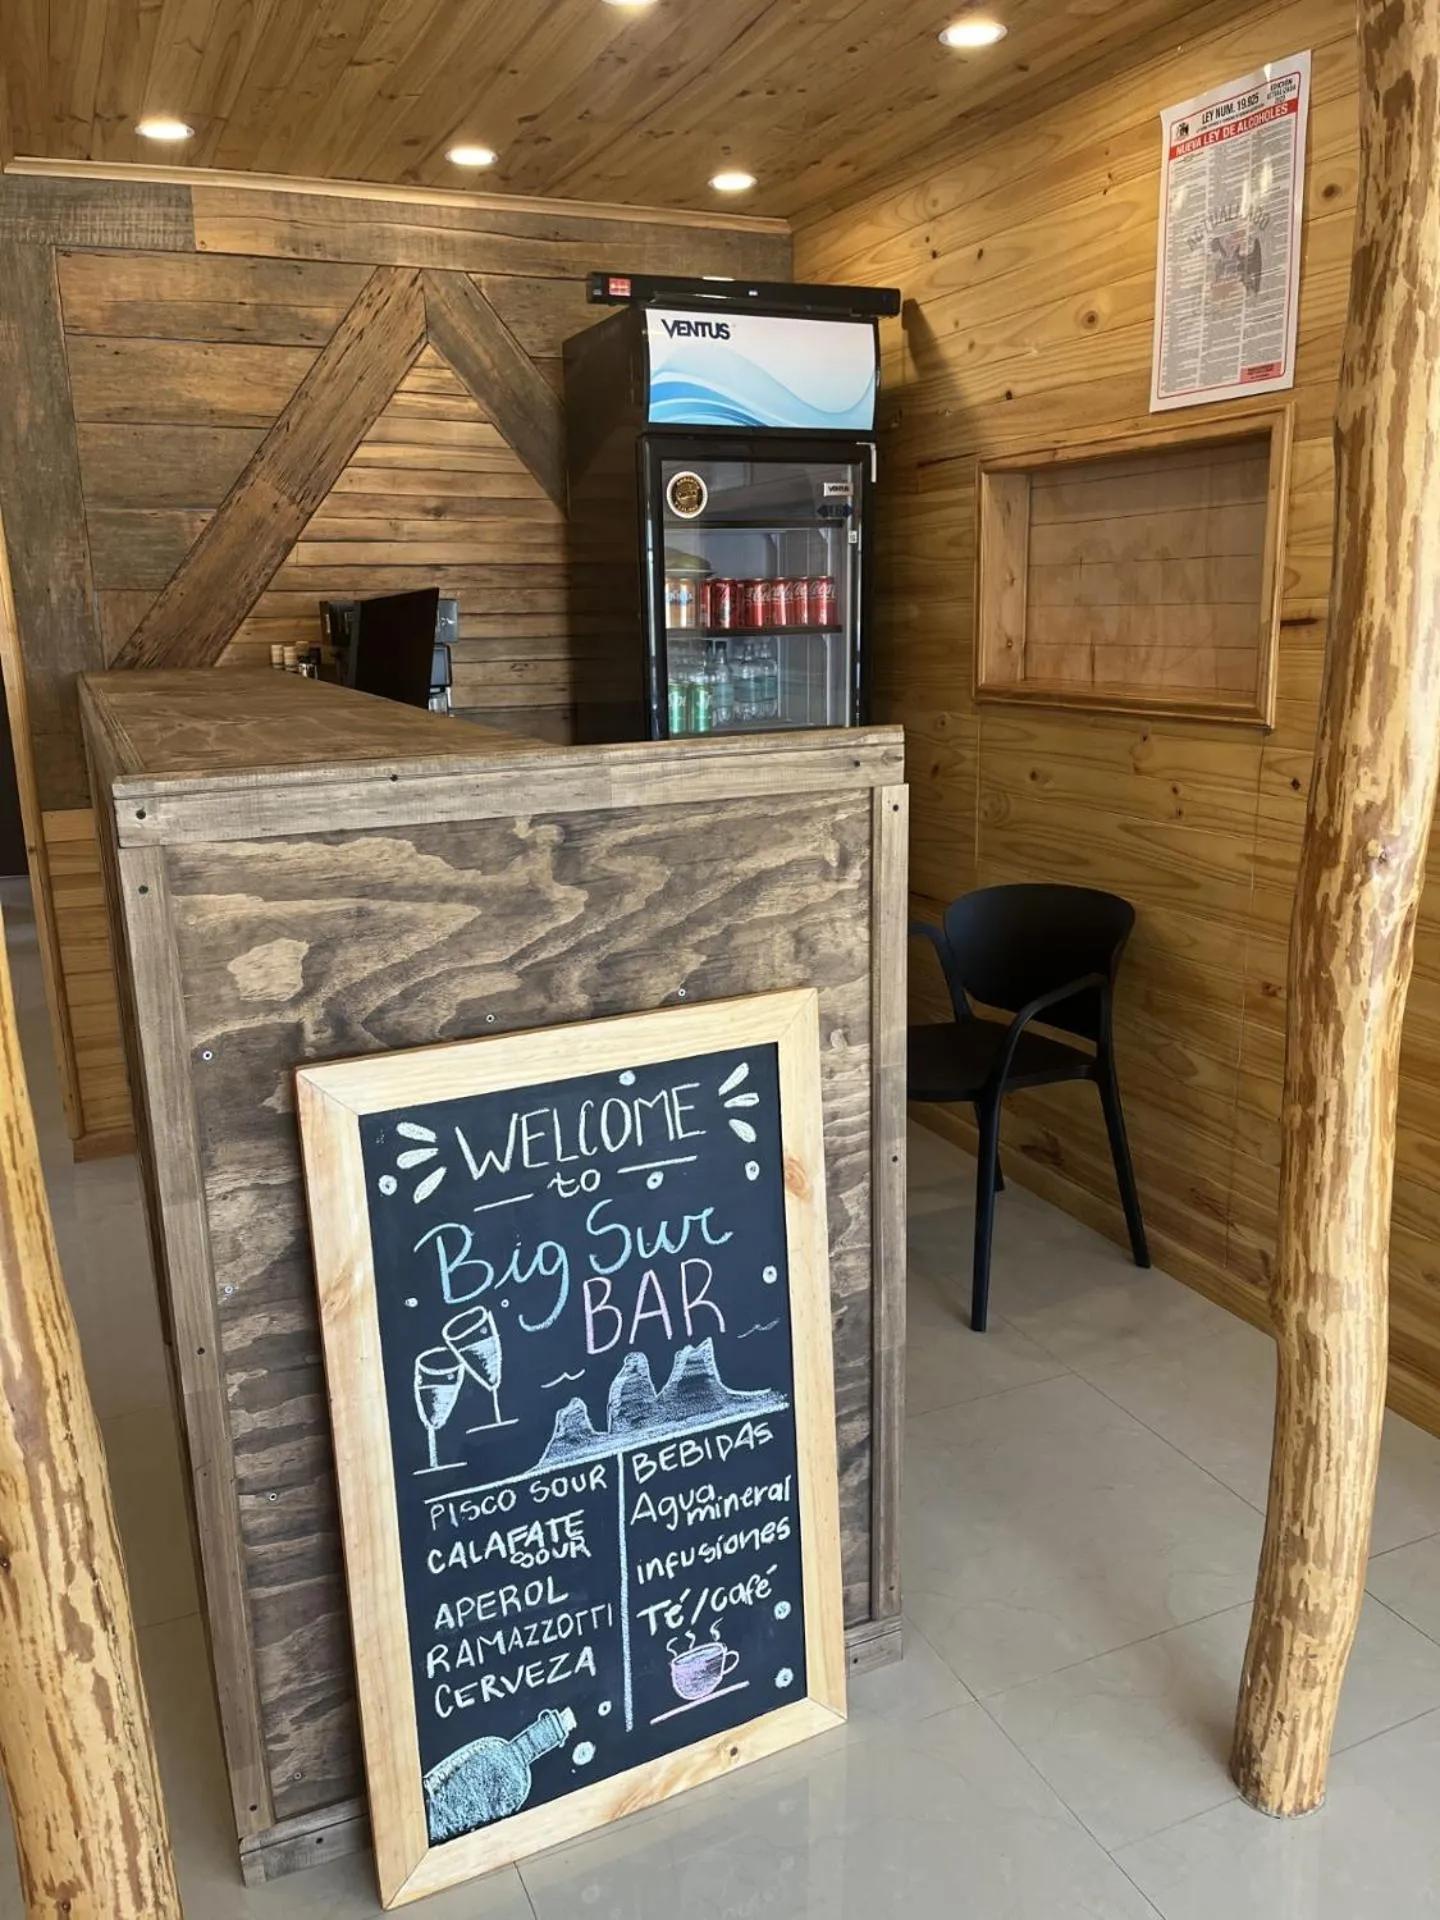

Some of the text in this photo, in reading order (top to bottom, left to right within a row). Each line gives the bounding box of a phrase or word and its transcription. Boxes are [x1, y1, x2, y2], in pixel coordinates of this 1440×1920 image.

[1176, 137, 1202, 156] NUEVA
[1203, 131, 1220, 144] LEY
[1223, 125, 1235, 139] DE
[1237, 103, 1289, 131] ALCOHOLES
[1202, 111, 1214, 124] LEY
[661, 319, 730, 340] VENTUS
[455, 1083, 706, 1180] WELCOME
[548, 1169, 600, 1197] to
[414, 1199, 734, 1332] Big Sur
[583, 1258, 726, 1354] BAR
[632, 1421, 774, 1482] BEBIDAS
[429, 1465, 608, 1530] PISCO SOUR
[630, 1484, 716, 1530] Agua
[687, 1475, 792, 1526] mineral
[428, 1511, 586, 1575] CALAFATE
[510, 1536, 591, 1568] SOUR
[434, 1576, 569, 1630] APEROL
[427, 1603, 613, 1678] RAMAZZOTTI
[435, 1646, 597, 1718] CERVEZA
